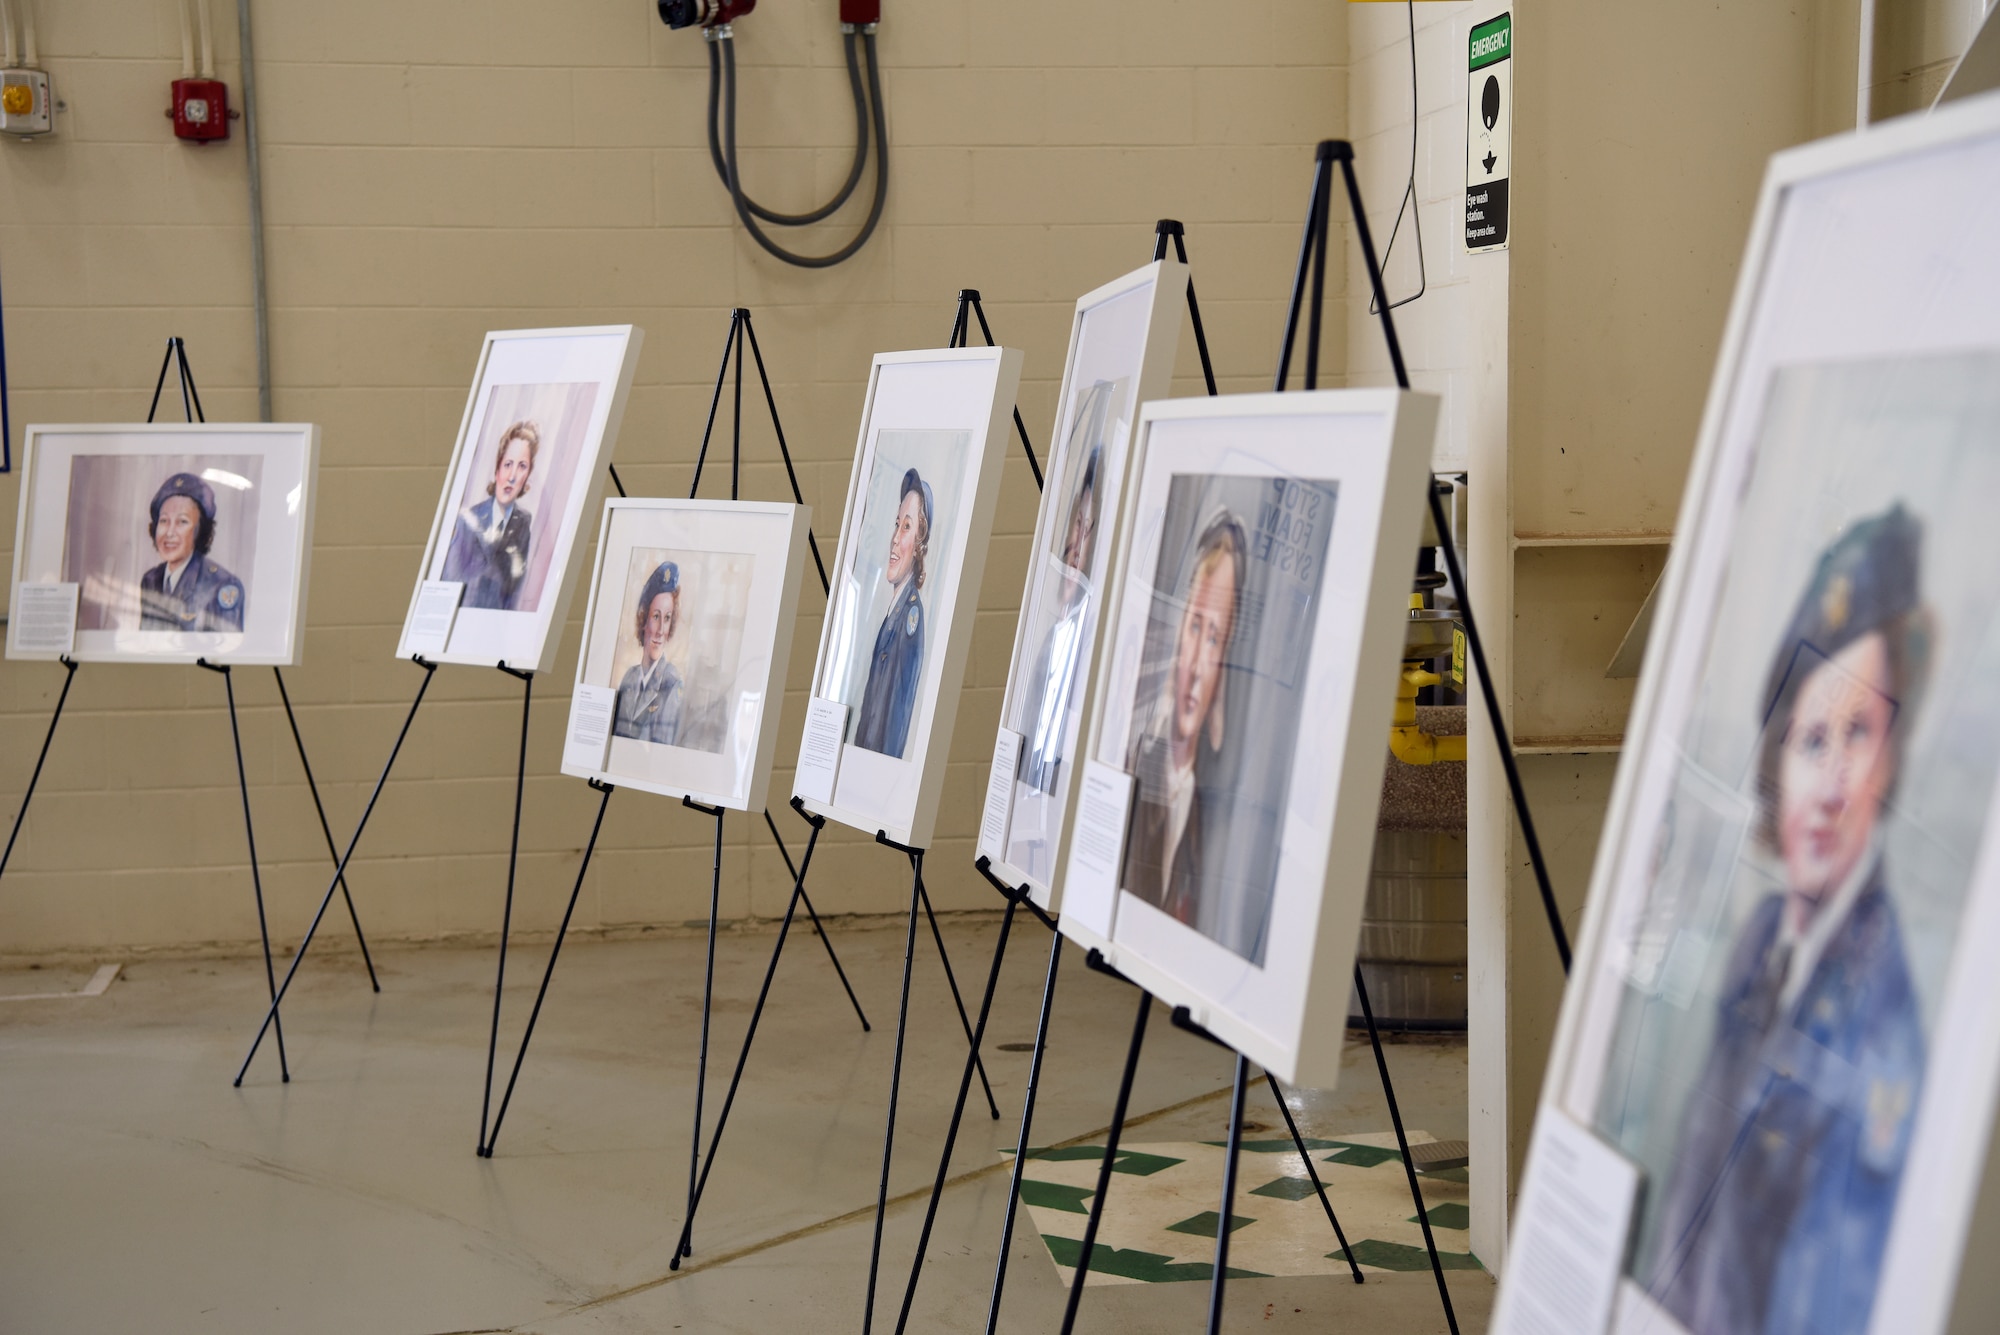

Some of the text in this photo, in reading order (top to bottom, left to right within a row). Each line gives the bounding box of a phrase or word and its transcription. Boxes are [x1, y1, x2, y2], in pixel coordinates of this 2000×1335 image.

[1471, 27, 1510, 60] EMERGENCY
[1467, 190, 1489, 209] Eye wash
[1467, 208, 1485, 222] station.
[1467, 224, 1497, 240] Keep area clear.
